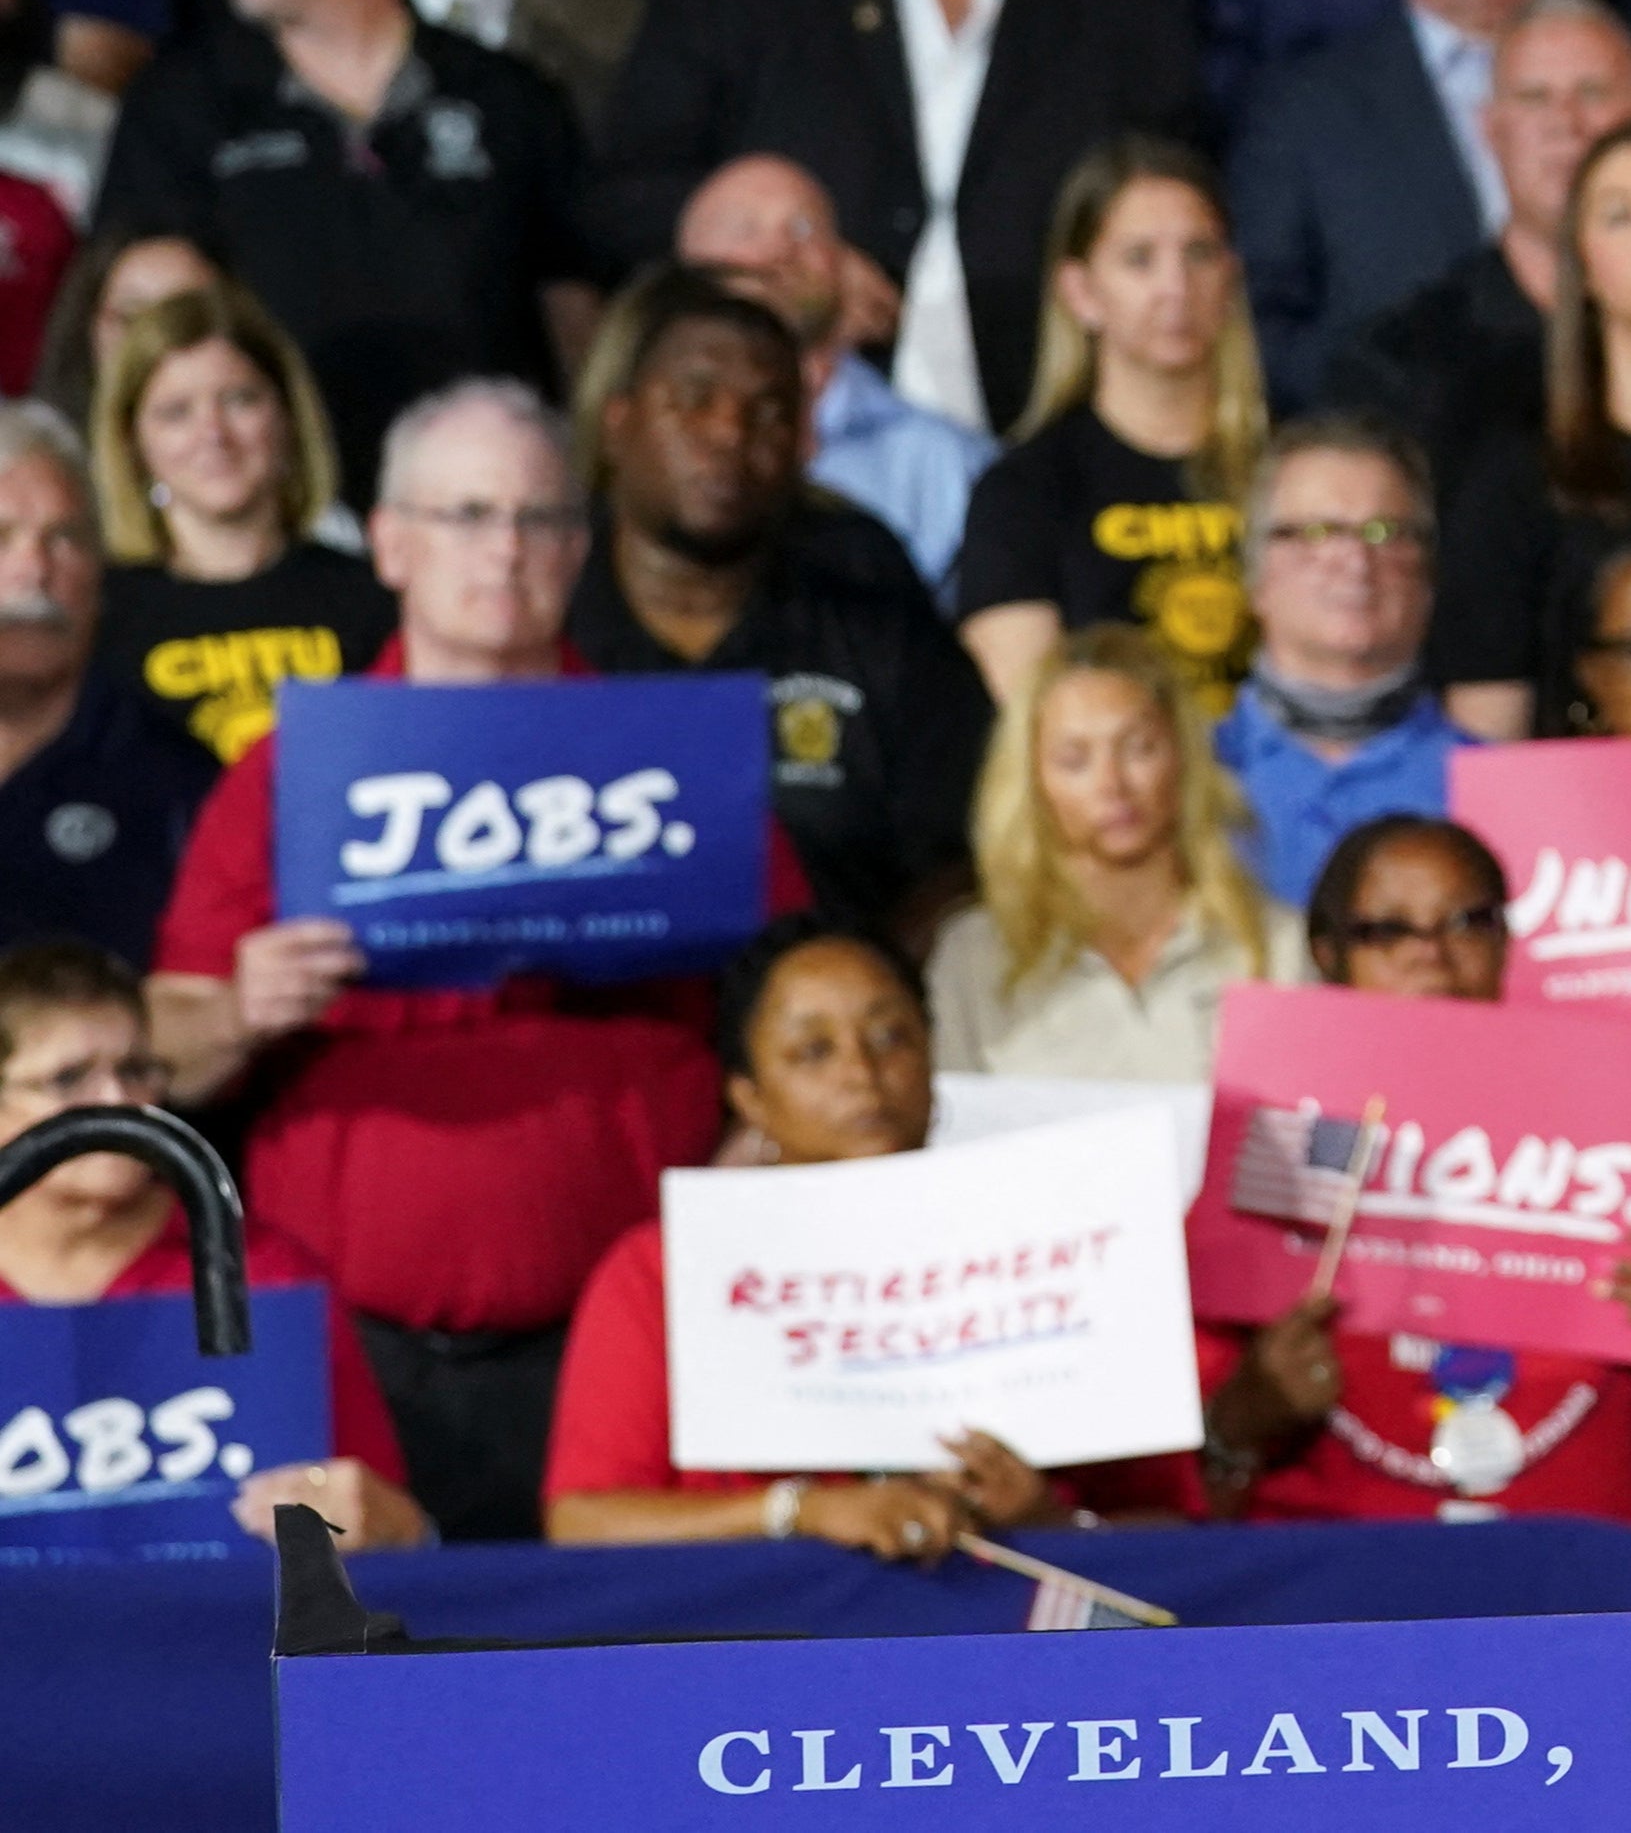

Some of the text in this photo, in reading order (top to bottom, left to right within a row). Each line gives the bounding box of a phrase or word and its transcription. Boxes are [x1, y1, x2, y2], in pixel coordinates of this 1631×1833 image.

[1091, 502, 1245, 562] CHT
[339, 767, 696, 879] JOBS.
[729, 1222, 1121, 1313] RETIREMENT
[0, 1385, 254, 1497] OBS.
[697, 1706, 1574, 1796] CLEVELAND,
